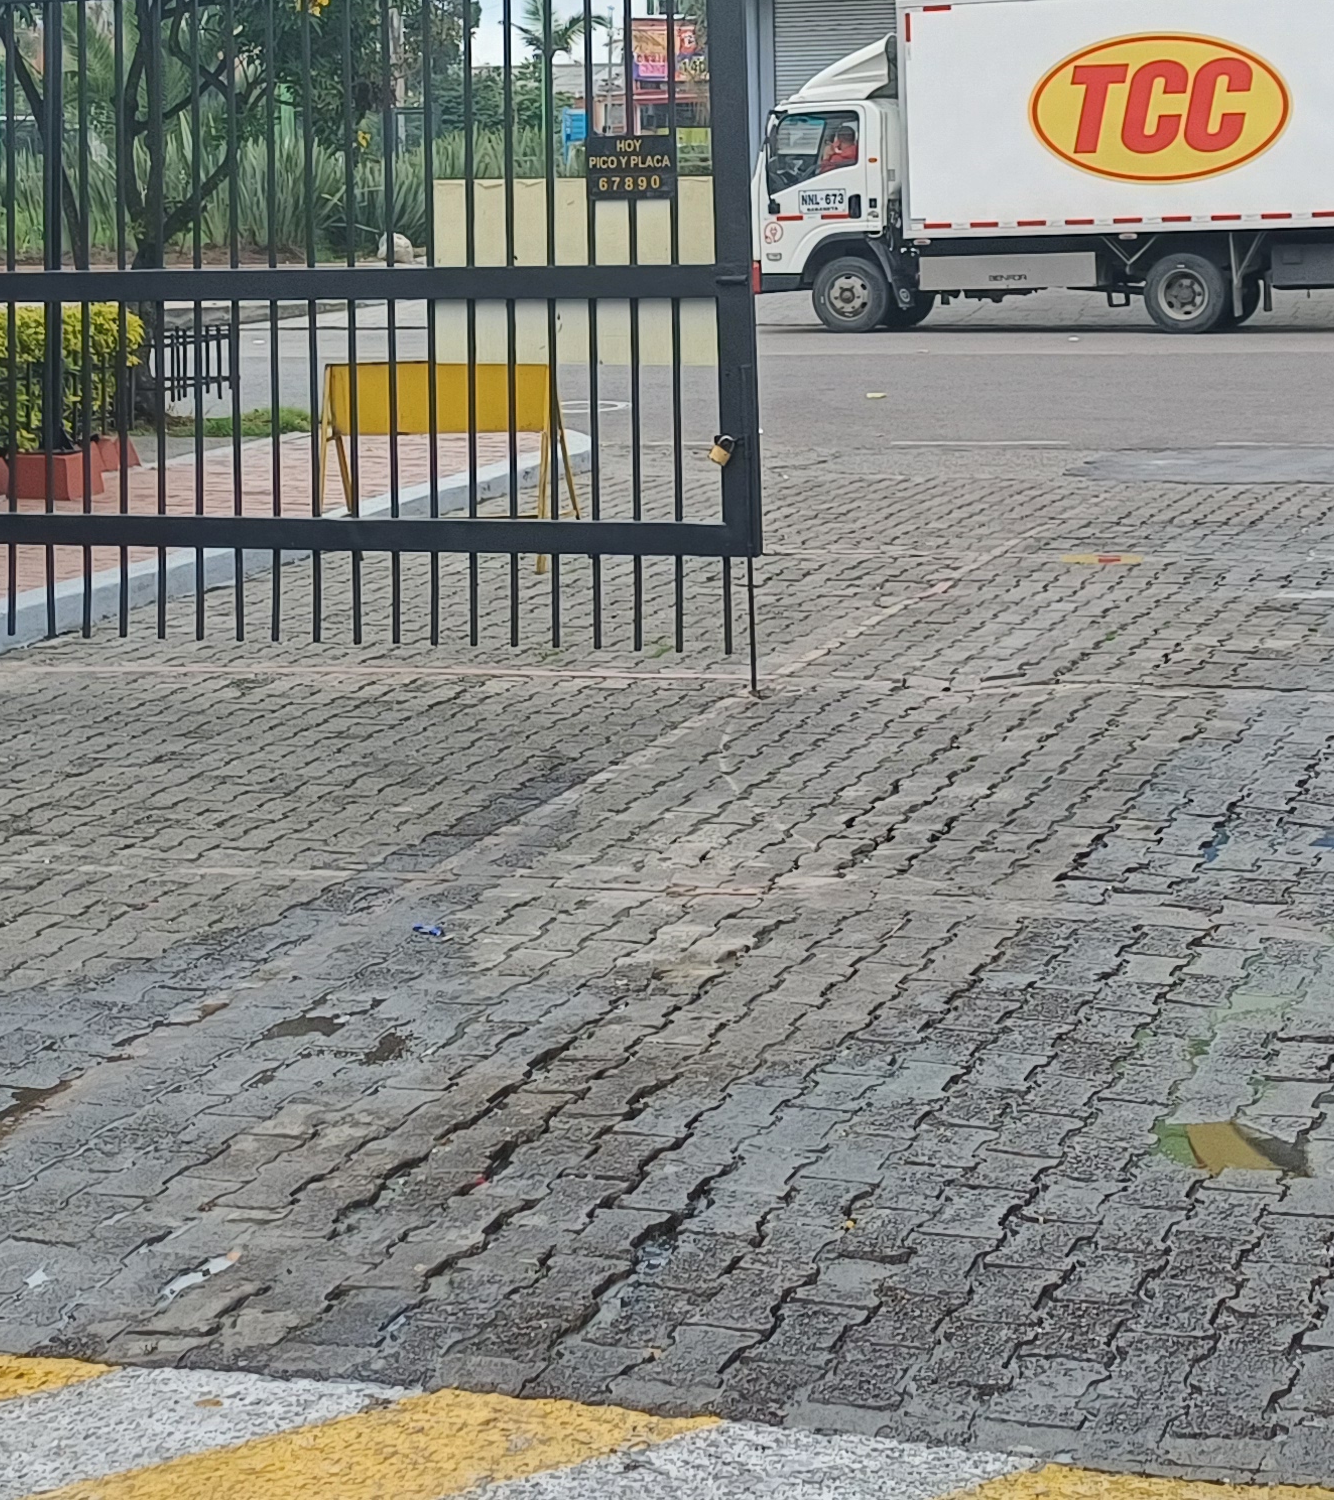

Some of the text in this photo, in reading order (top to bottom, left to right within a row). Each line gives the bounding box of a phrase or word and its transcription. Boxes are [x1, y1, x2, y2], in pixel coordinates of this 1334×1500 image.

[1070, 56, 1254, 155] TCC
[616, 139, 642, 152] HOY
[588, 155, 671, 169] PICO Y PLACA
